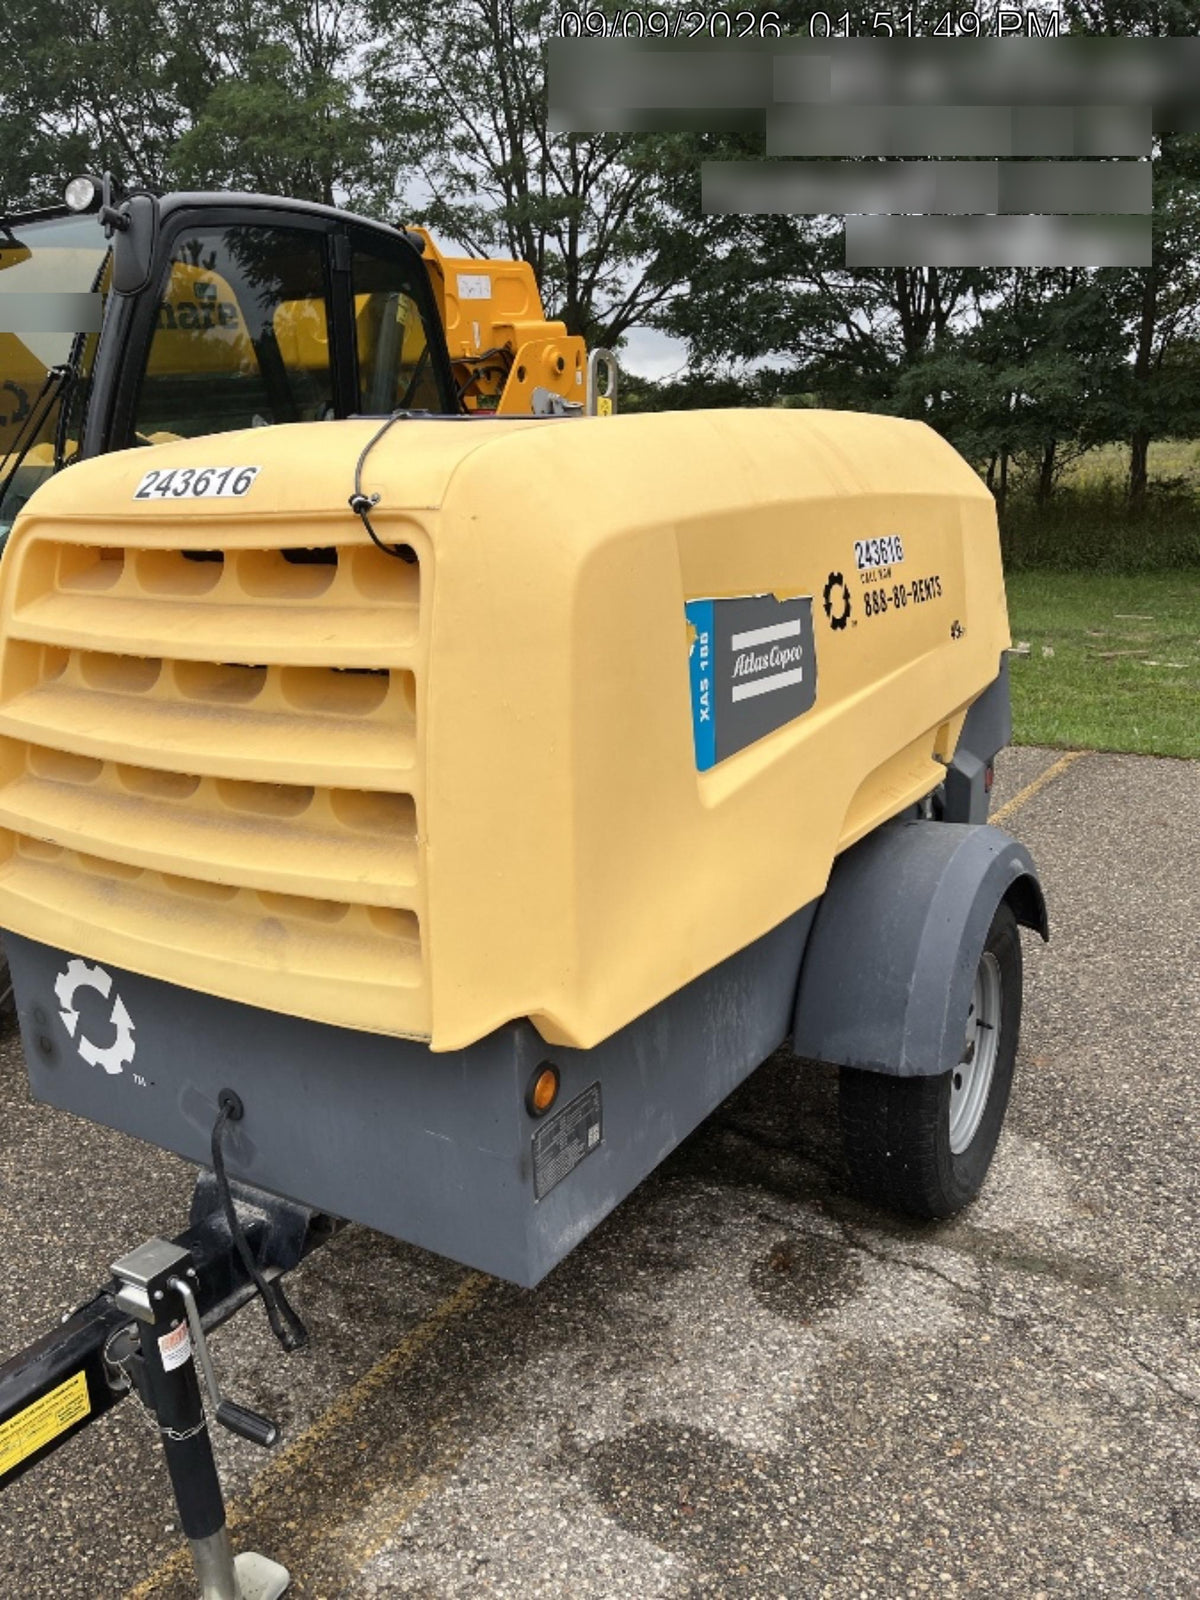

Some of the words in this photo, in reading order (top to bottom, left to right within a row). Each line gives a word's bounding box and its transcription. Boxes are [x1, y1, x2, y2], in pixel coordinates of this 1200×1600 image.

[134, 466, 258, 499] 243616
[854, 536, 904, 570] 243616
[700, 678, 710, 722] XAS
